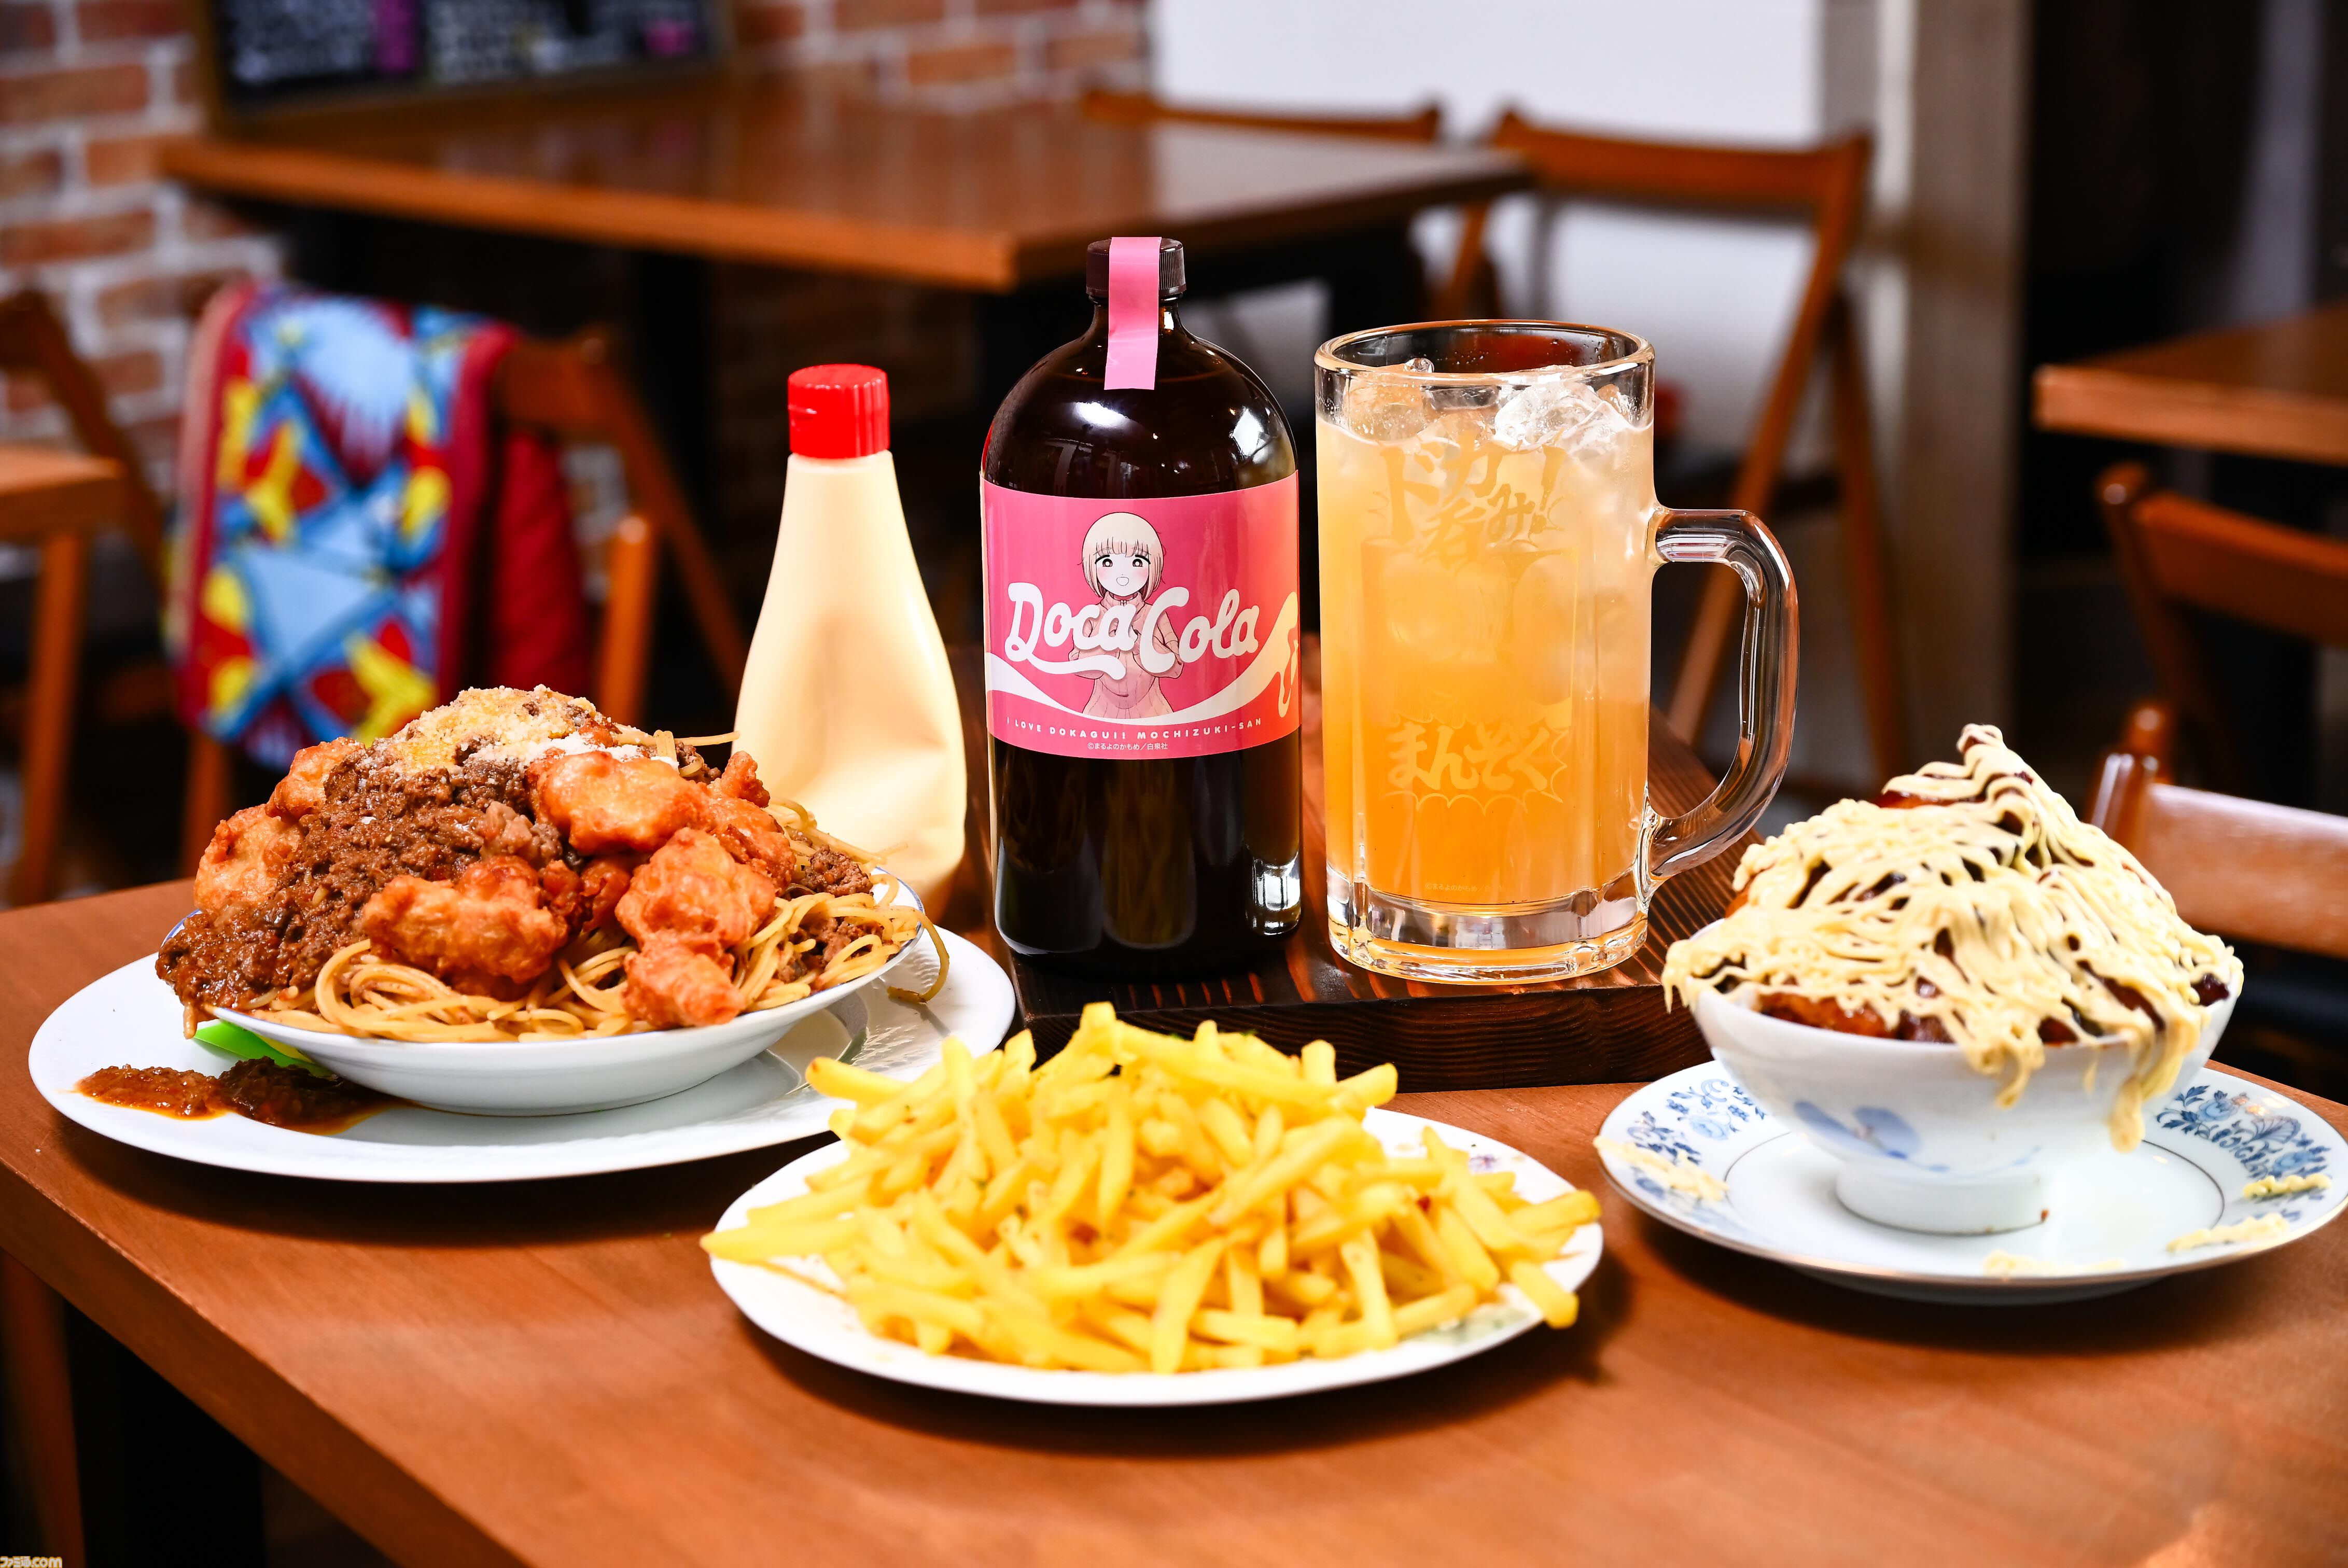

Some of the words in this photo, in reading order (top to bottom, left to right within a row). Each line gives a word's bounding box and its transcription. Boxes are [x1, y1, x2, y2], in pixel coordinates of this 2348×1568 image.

[1004, 582, 1137, 680] Doca
[1140, 586, 1260, 673] Cola
[1007, 716, 1010, 724] I
[1015, 719, 1042, 732] LOVE
[1049, 726, 1126, 739] DOKAGUI!
[1137, 717, 1262, 739] MOCHIZUKI-SAN
[1387, 721, 1550, 791] まんぞく
